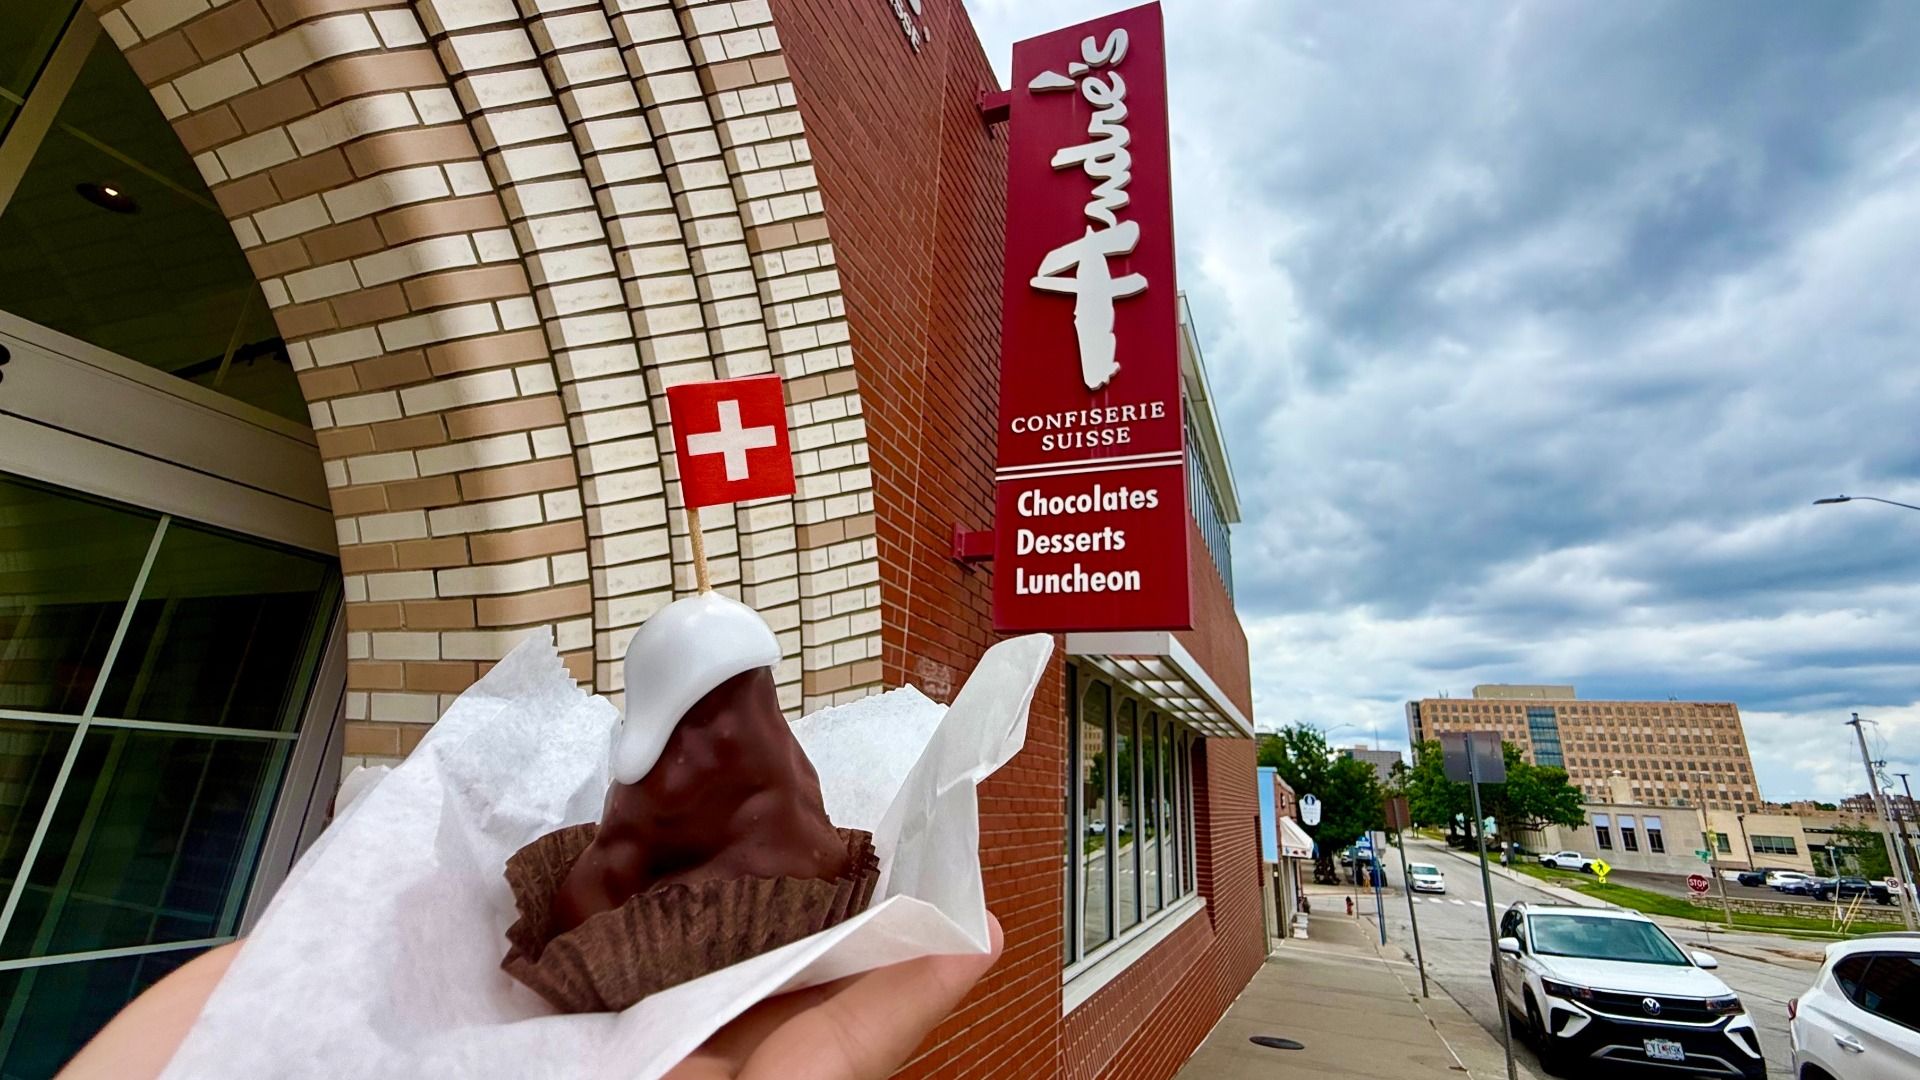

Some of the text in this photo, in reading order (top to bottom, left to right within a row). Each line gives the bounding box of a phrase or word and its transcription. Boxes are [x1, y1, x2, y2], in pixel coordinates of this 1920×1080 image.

[1028, 28, 1149, 390] André's
[1011, 401, 1166, 434] CONFISERIE
[1041, 426, 1131, 451] SUISSE
[1017, 484, 1159, 517] Chocolates
[1016, 527, 1126, 556] Desserts
[1016, 563, 1141, 595] Luncheon
[1689, 878, 1708, 887] STOP
